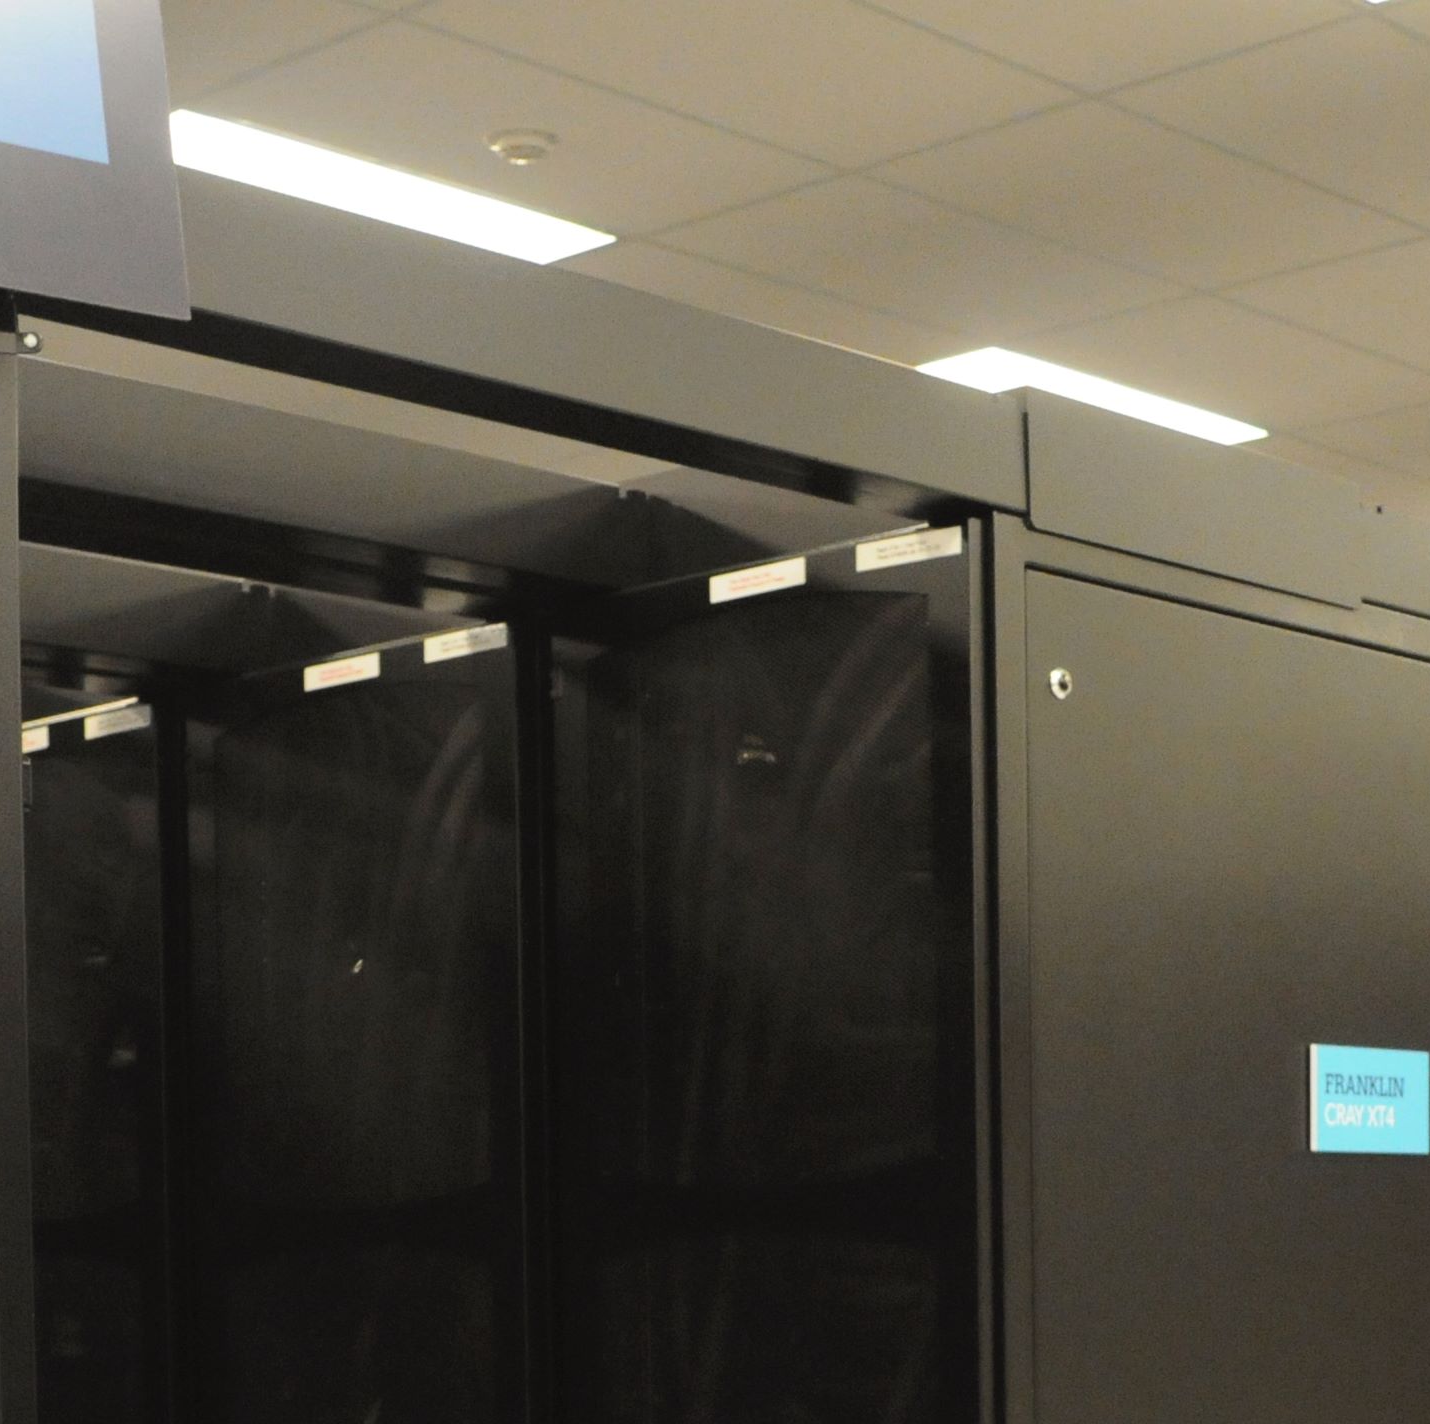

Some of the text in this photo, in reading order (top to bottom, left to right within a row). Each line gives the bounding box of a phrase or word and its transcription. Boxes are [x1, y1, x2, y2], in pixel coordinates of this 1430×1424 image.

[1324, 1073, 1405, 1098] FRANKLIN
[1324, 1102, 1396, 1128] CRAY XT4
